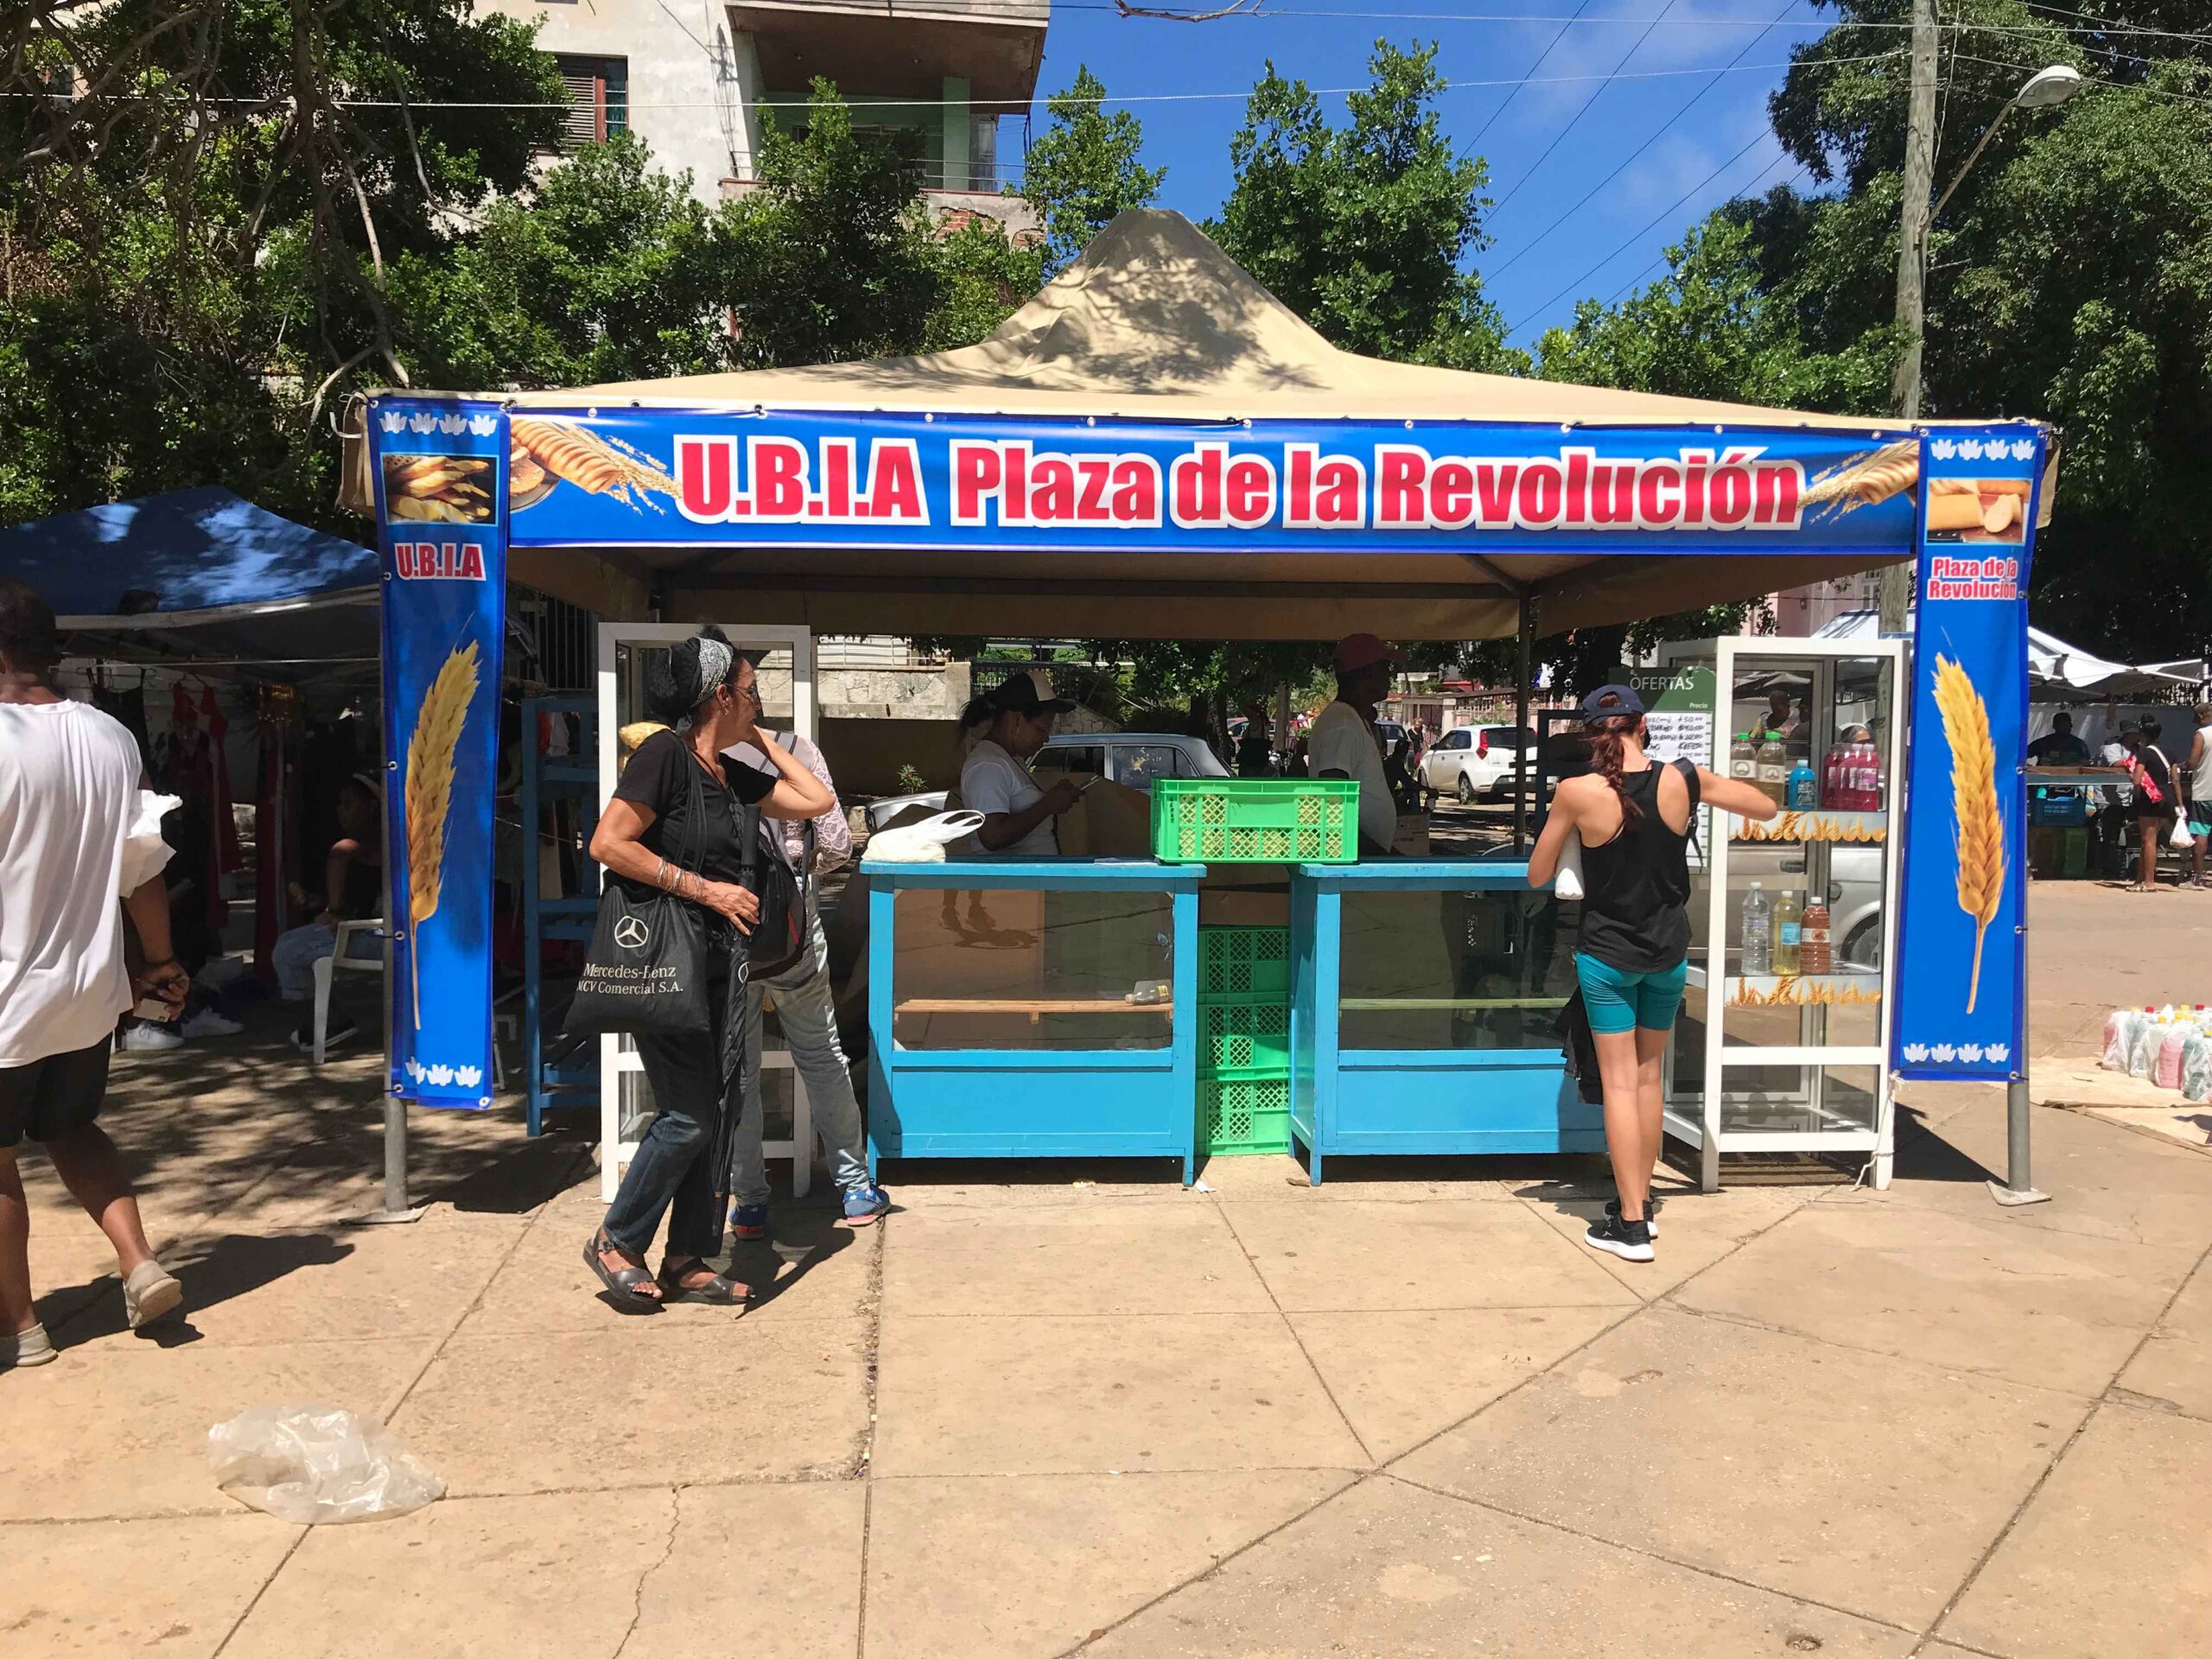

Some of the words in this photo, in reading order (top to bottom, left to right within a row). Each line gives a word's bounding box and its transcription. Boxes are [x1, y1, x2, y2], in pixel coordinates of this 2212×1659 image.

[674, 435, 931, 525] U.B.I.A
[949, 439, 1162, 529] Plaza
[1169, 442, 1276, 530] de
[1283, 442, 1366, 531] la
[1374, 444, 1807, 532] Revolución
[394, 543, 486, 581] U.B.I.A
[1931, 556, 1980, 578] Plaza
[1982, 556, 2005, 578] de
[2005, 557, 2018, 578] la
[1927, 578, 2017, 600] Revolución
[1630, 677, 1694, 690] OFERTAS
[583, 963, 677, 979] Mercedes-Benz
[598, 981, 655, 995] Comercial
[658, 981, 683, 993] S.A.
